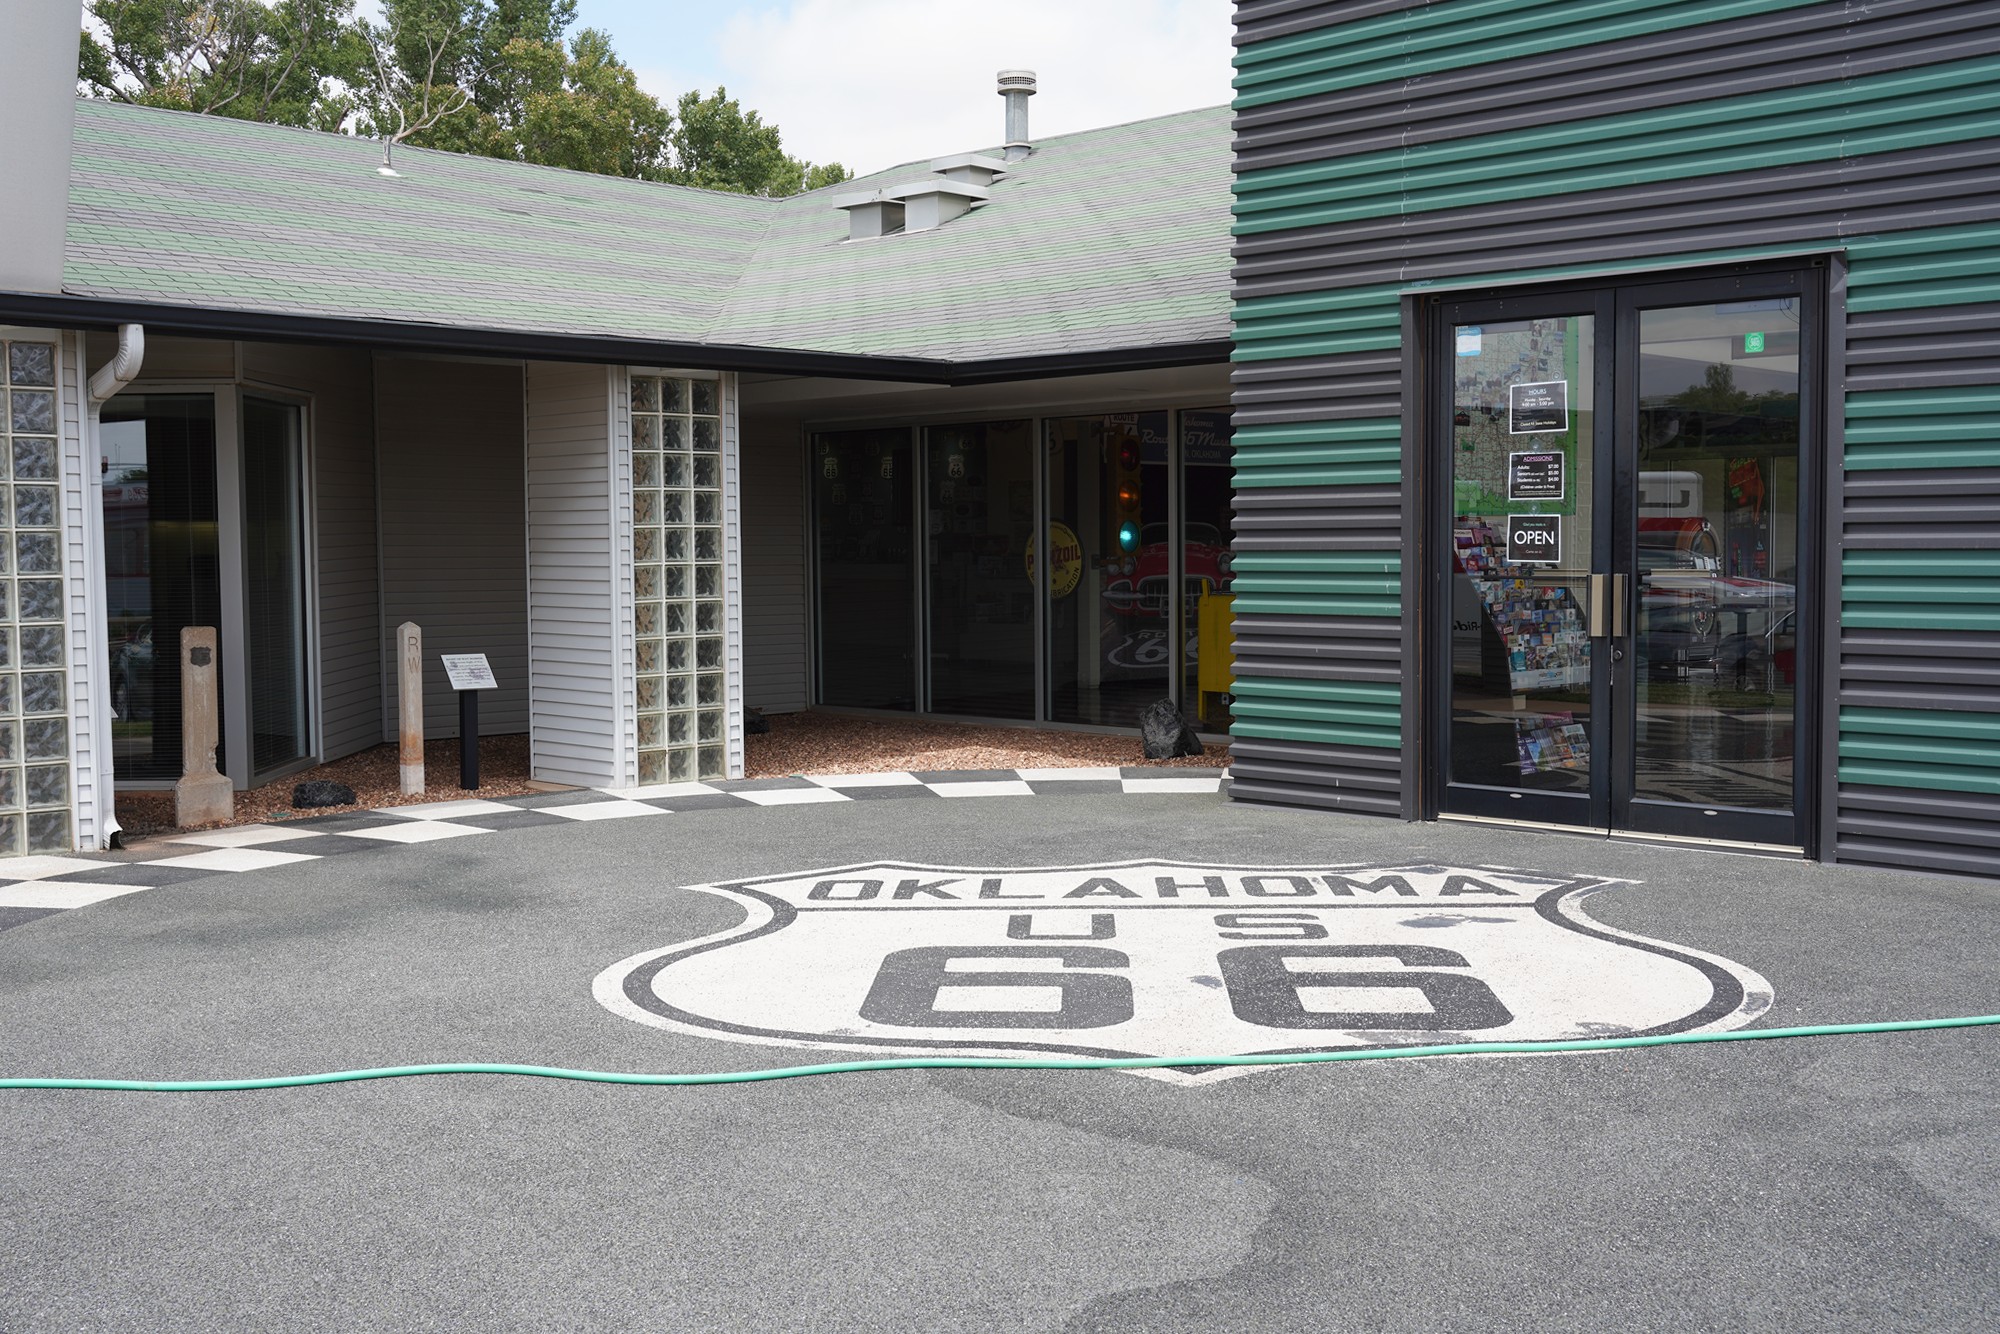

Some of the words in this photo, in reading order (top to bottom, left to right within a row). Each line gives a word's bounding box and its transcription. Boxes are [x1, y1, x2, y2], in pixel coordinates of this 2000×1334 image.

[1141, 429, 1168, 443] Rou
[951, 467, 962, 476] 66
[1514, 530, 1554, 545] OPEN
[1027, 544, 1080, 570] PZOIL
[1050, 567, 1079, 597] BRICATION
[806, 874, 1520, 901] OKLAHOMA
[1006, 912, 1329, 941] US
[858, 944, 1514, 1031] 66
